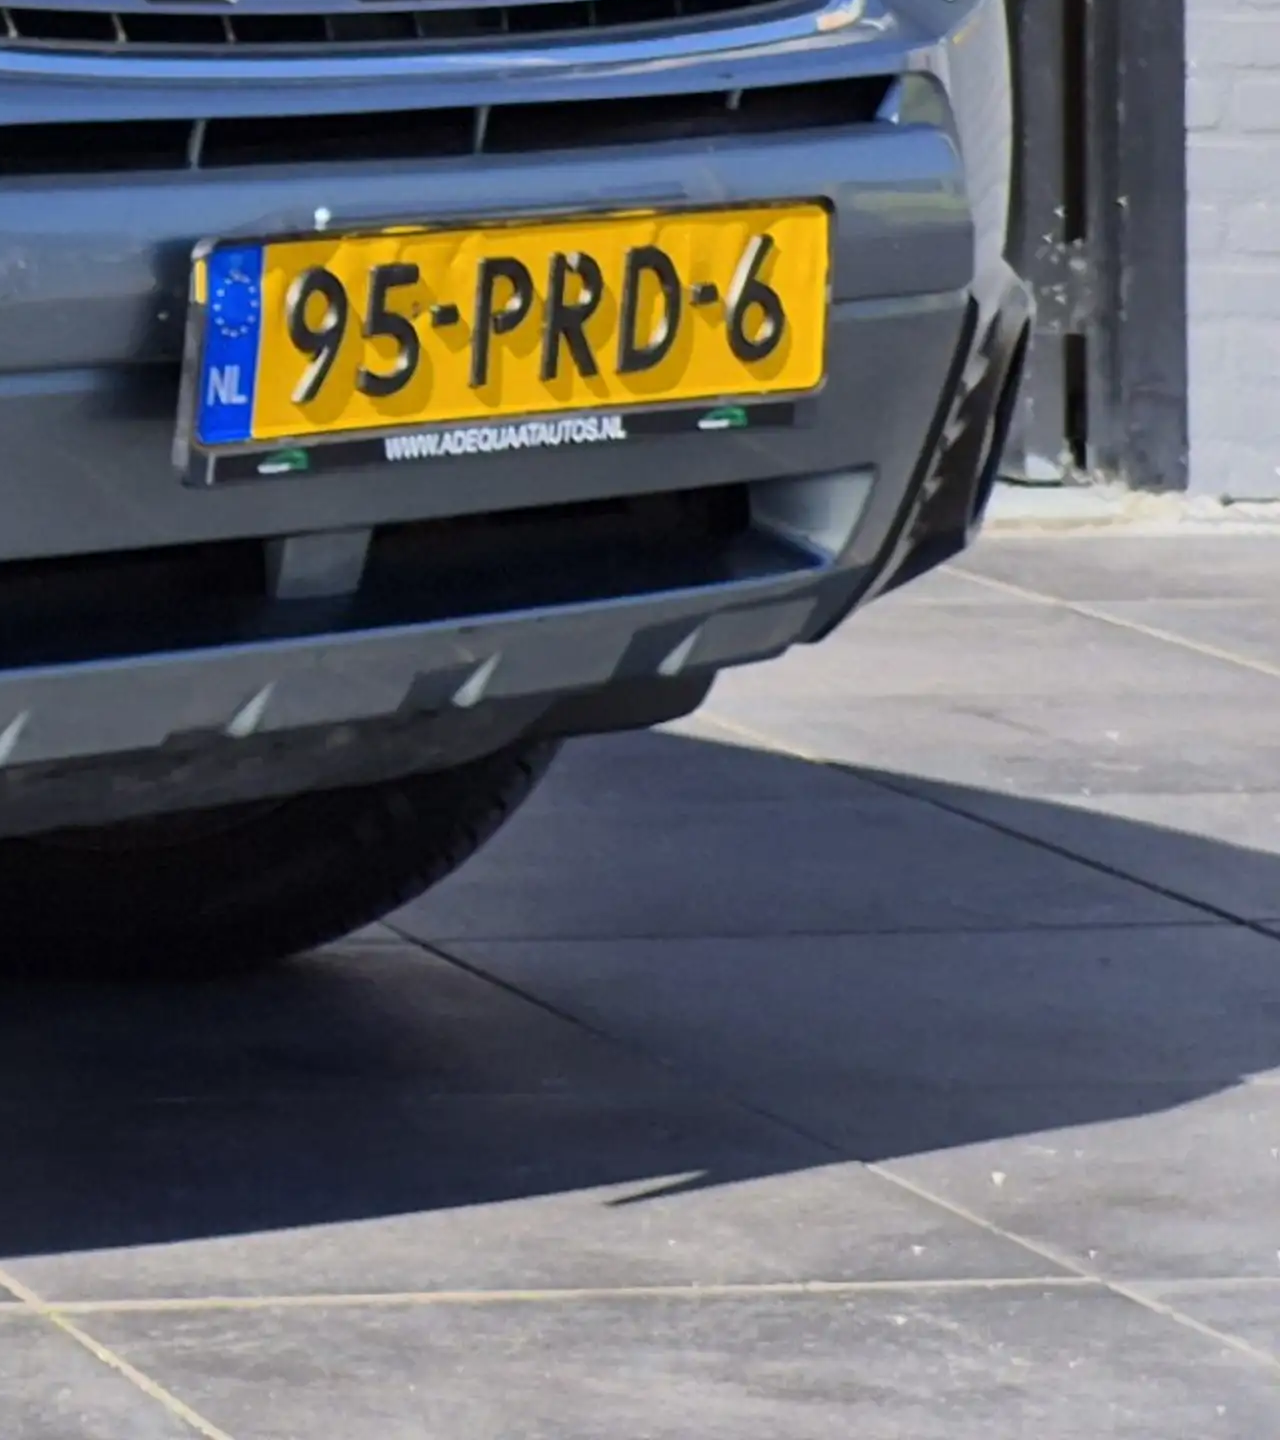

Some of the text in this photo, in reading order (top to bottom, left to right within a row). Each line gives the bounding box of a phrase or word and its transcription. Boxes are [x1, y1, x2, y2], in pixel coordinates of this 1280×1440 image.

[285, 233, 786, 405] 95-PRD-6
[206, 363, 248, 407] NL
[384, 415, 627, 461] WWW.ADEQUAATAUTOS.NL
